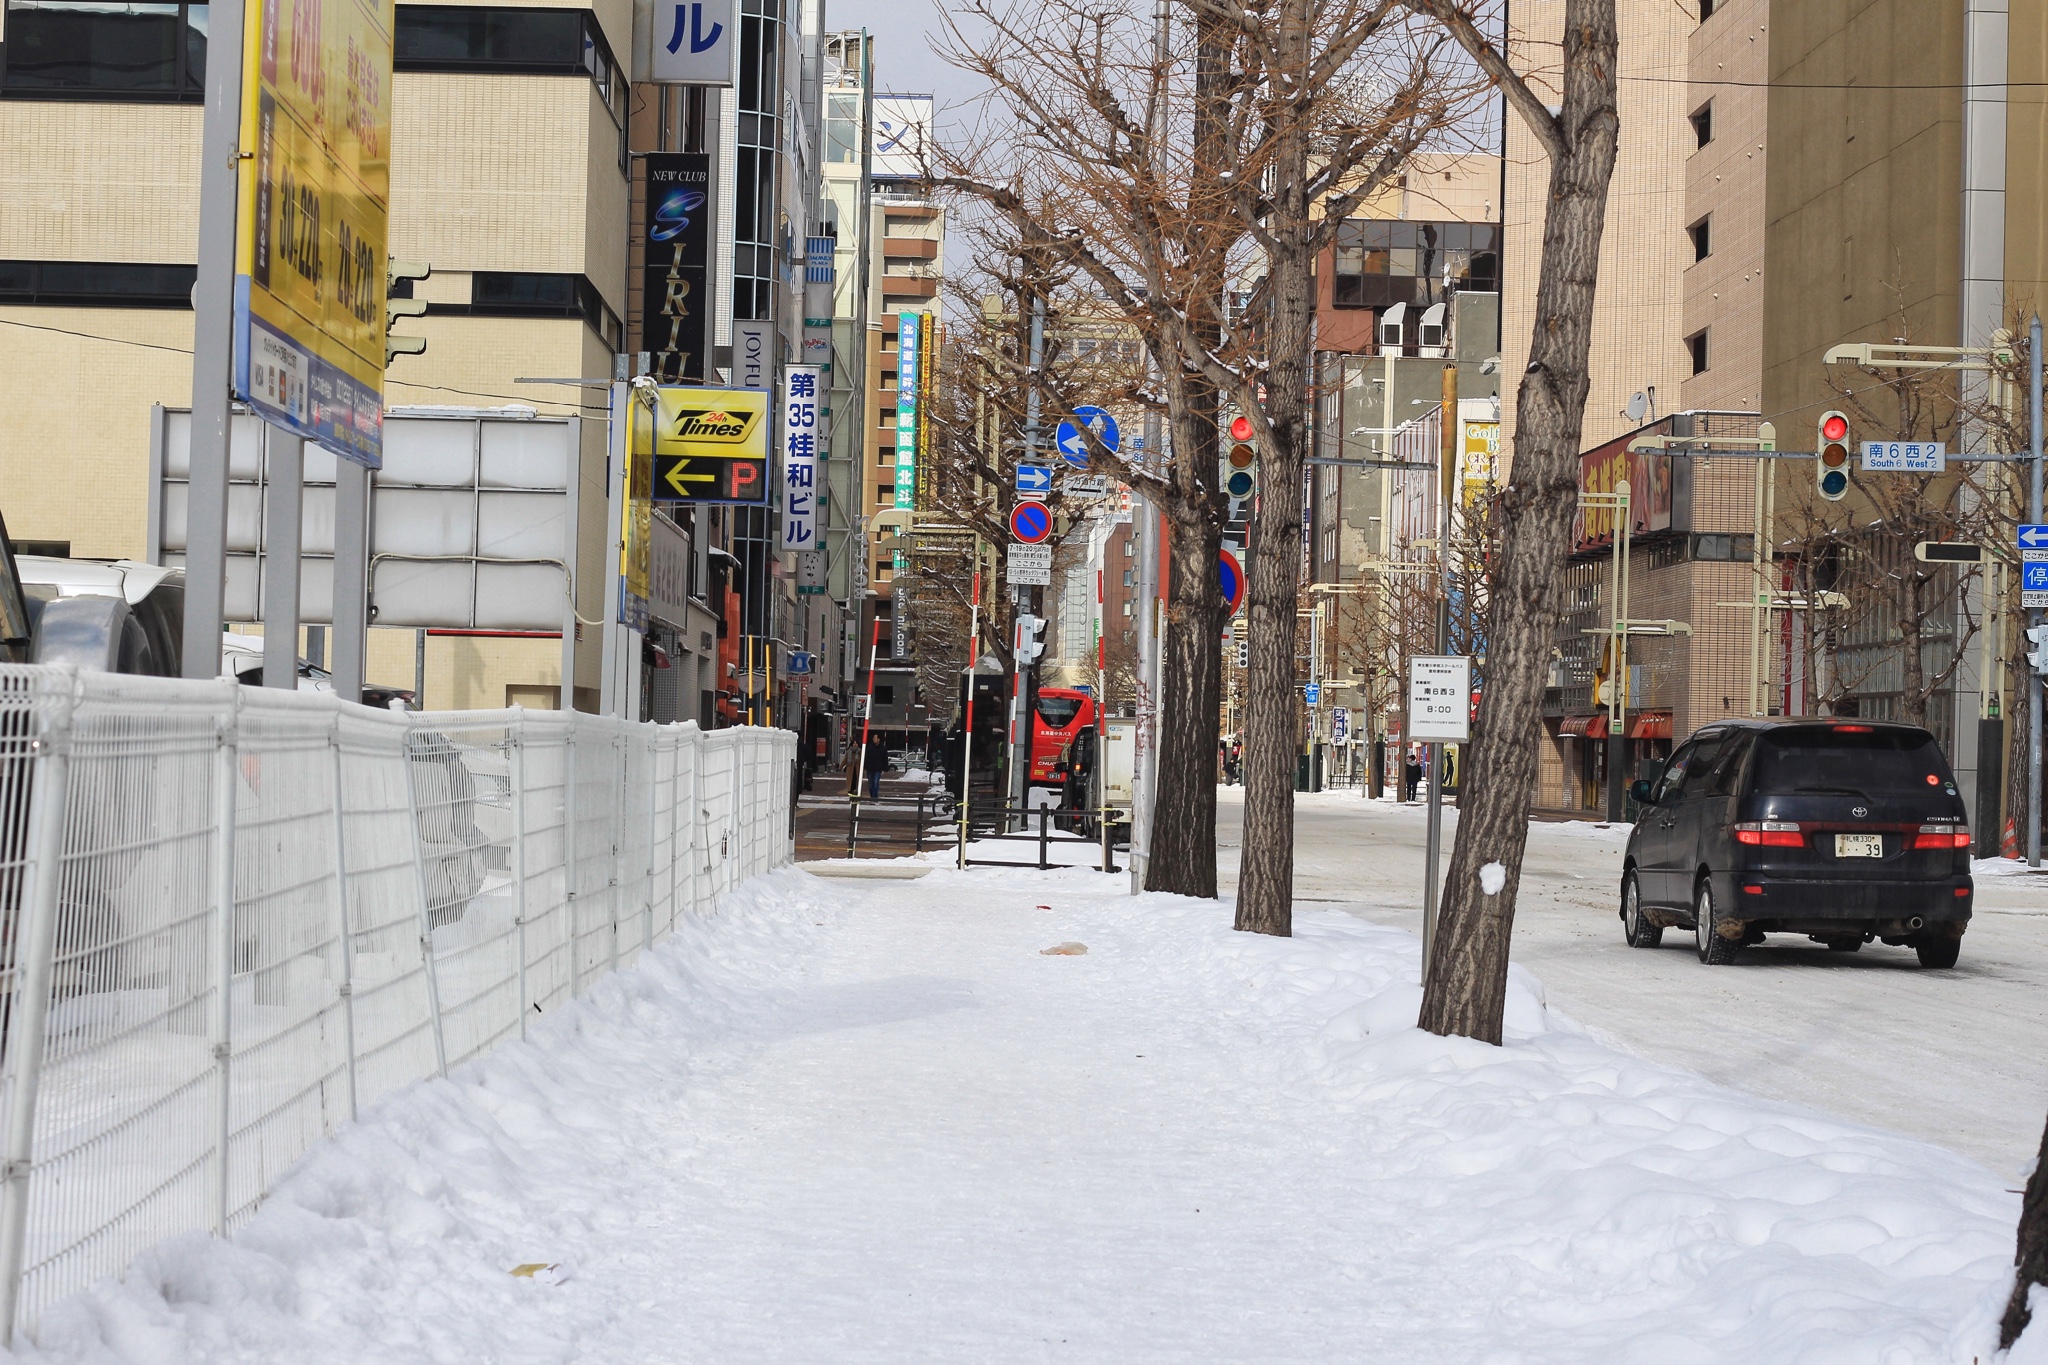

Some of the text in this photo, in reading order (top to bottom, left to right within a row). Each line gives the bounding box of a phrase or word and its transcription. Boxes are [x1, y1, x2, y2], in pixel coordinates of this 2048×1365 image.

[666, 3, 723, 54] ル
[877, 121, 908, 152] ン
[653, 171, 706, 182] NEW CLUB
[678, 417, 744, 436] Times
[787, 373, 816, 544] 第35桂和ビル
[1869, 444, 1936, 459] 南6西2
[1870, 459, 1894, 468] South
[1896, 460, 1902, 468] 6
[1907, 460, 1928, 468] West
[731, 462, 757, 498] P
[2027, 567, 2048, 586] 停
[1424, 687, 1455, 696] 南6西3
[1426, 705, 1452, 713] 8:00
[1866, 844, 1880, 856] 39
